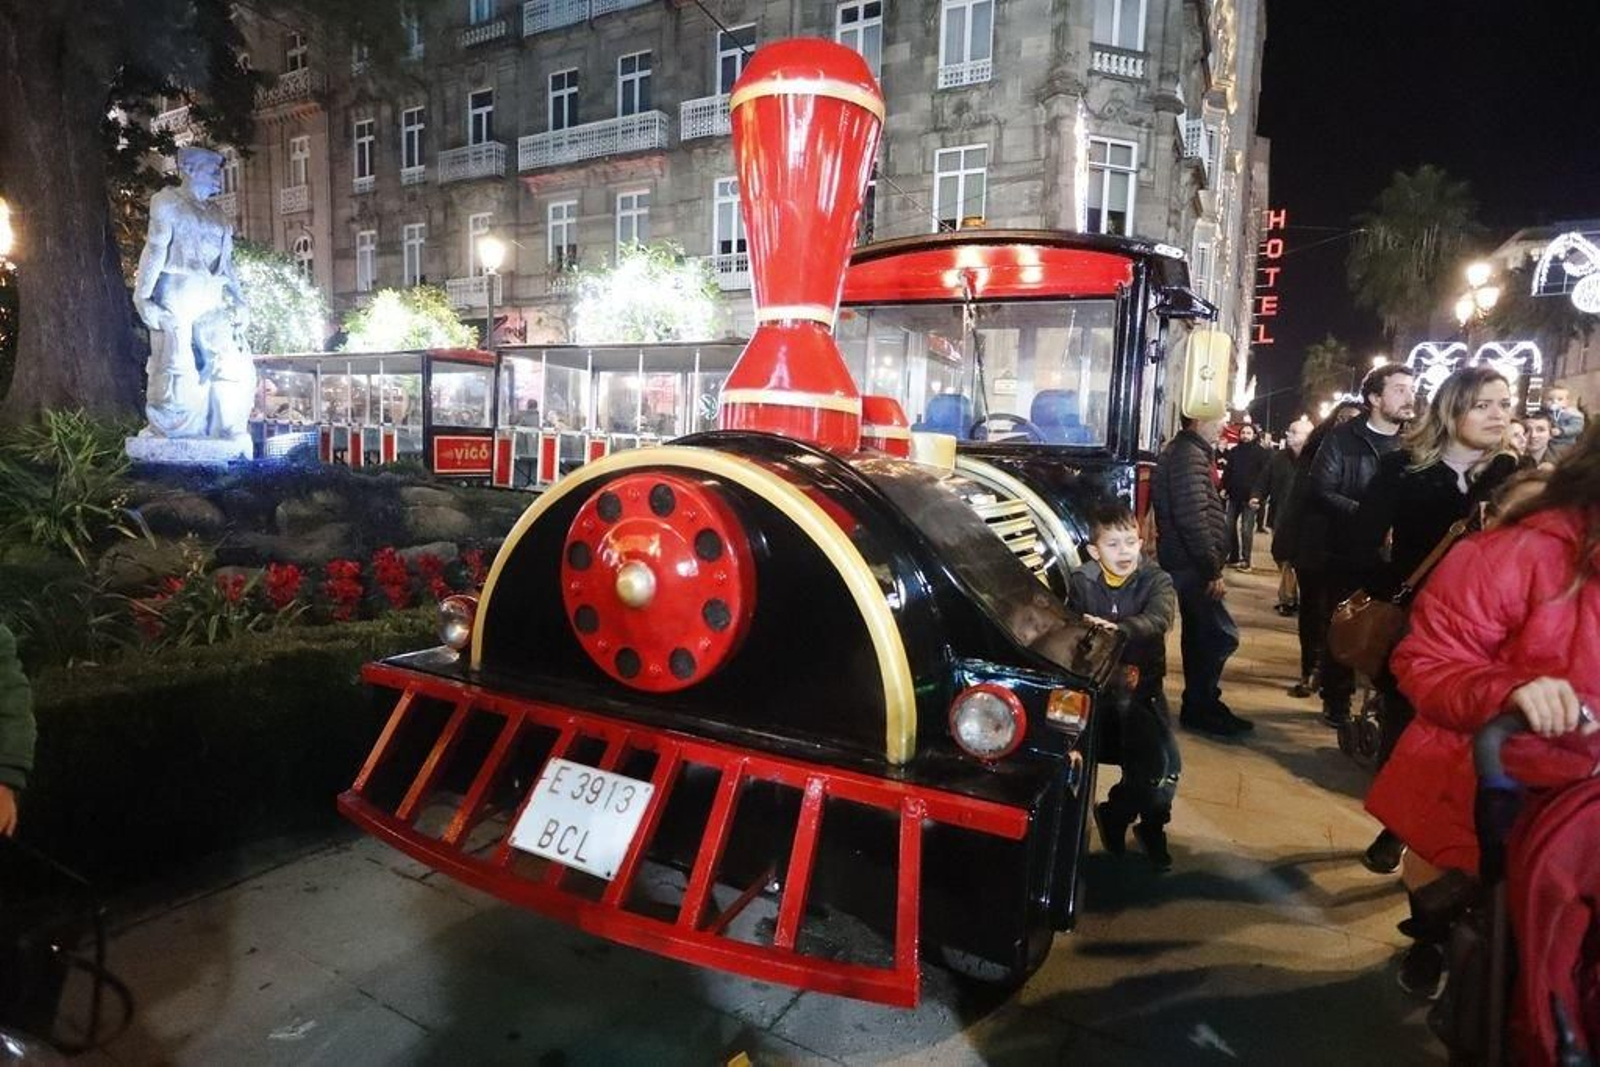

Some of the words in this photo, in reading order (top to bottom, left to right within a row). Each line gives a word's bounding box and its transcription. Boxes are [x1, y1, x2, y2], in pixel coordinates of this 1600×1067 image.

[1257, 210, 1286, 344] HOTEL
[548, 766, 571, 794] E
[571, 772, 636, 814] 3913
[537, 819, 589, 862] BCL
